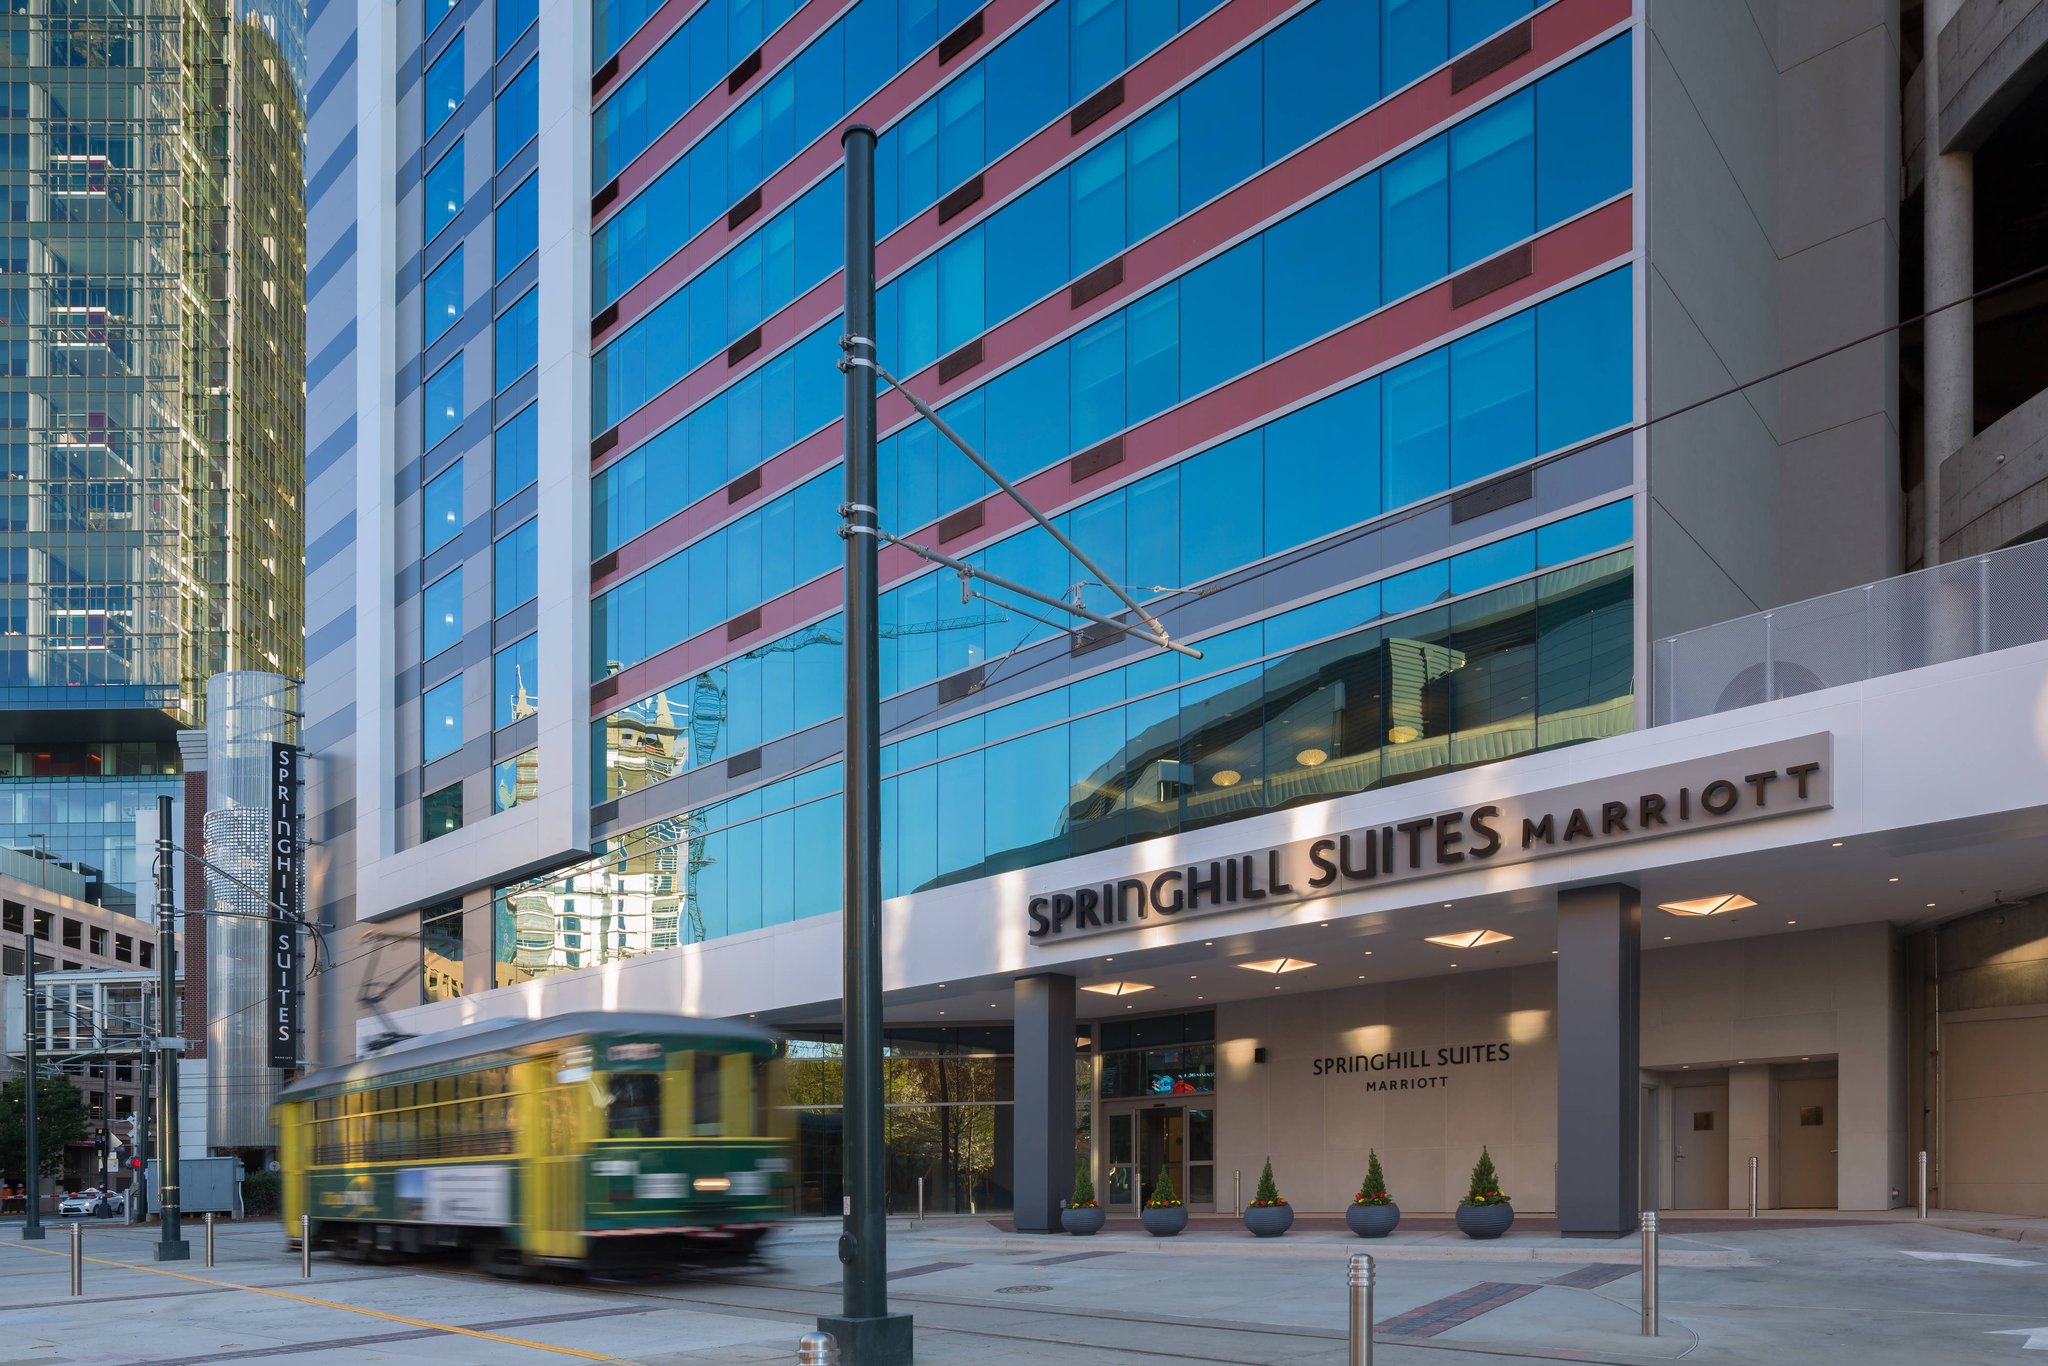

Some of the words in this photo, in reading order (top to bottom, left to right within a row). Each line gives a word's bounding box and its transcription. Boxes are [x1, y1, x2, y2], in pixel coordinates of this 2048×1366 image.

[1028, 849, 1293, 937] SPRINGHILL
[1308, 805, 1502, 888] SUITES
[1521, 762, 1820, 848] MARRIOTT
[277, 934, 291, 1041] SUITES
[1313, 1050, 1430, 1075] SPRINGHILL
[1437, 1043, 1510, 1067] SUITES
[1366, 1076, 1449, 1092] MARRIOTT
